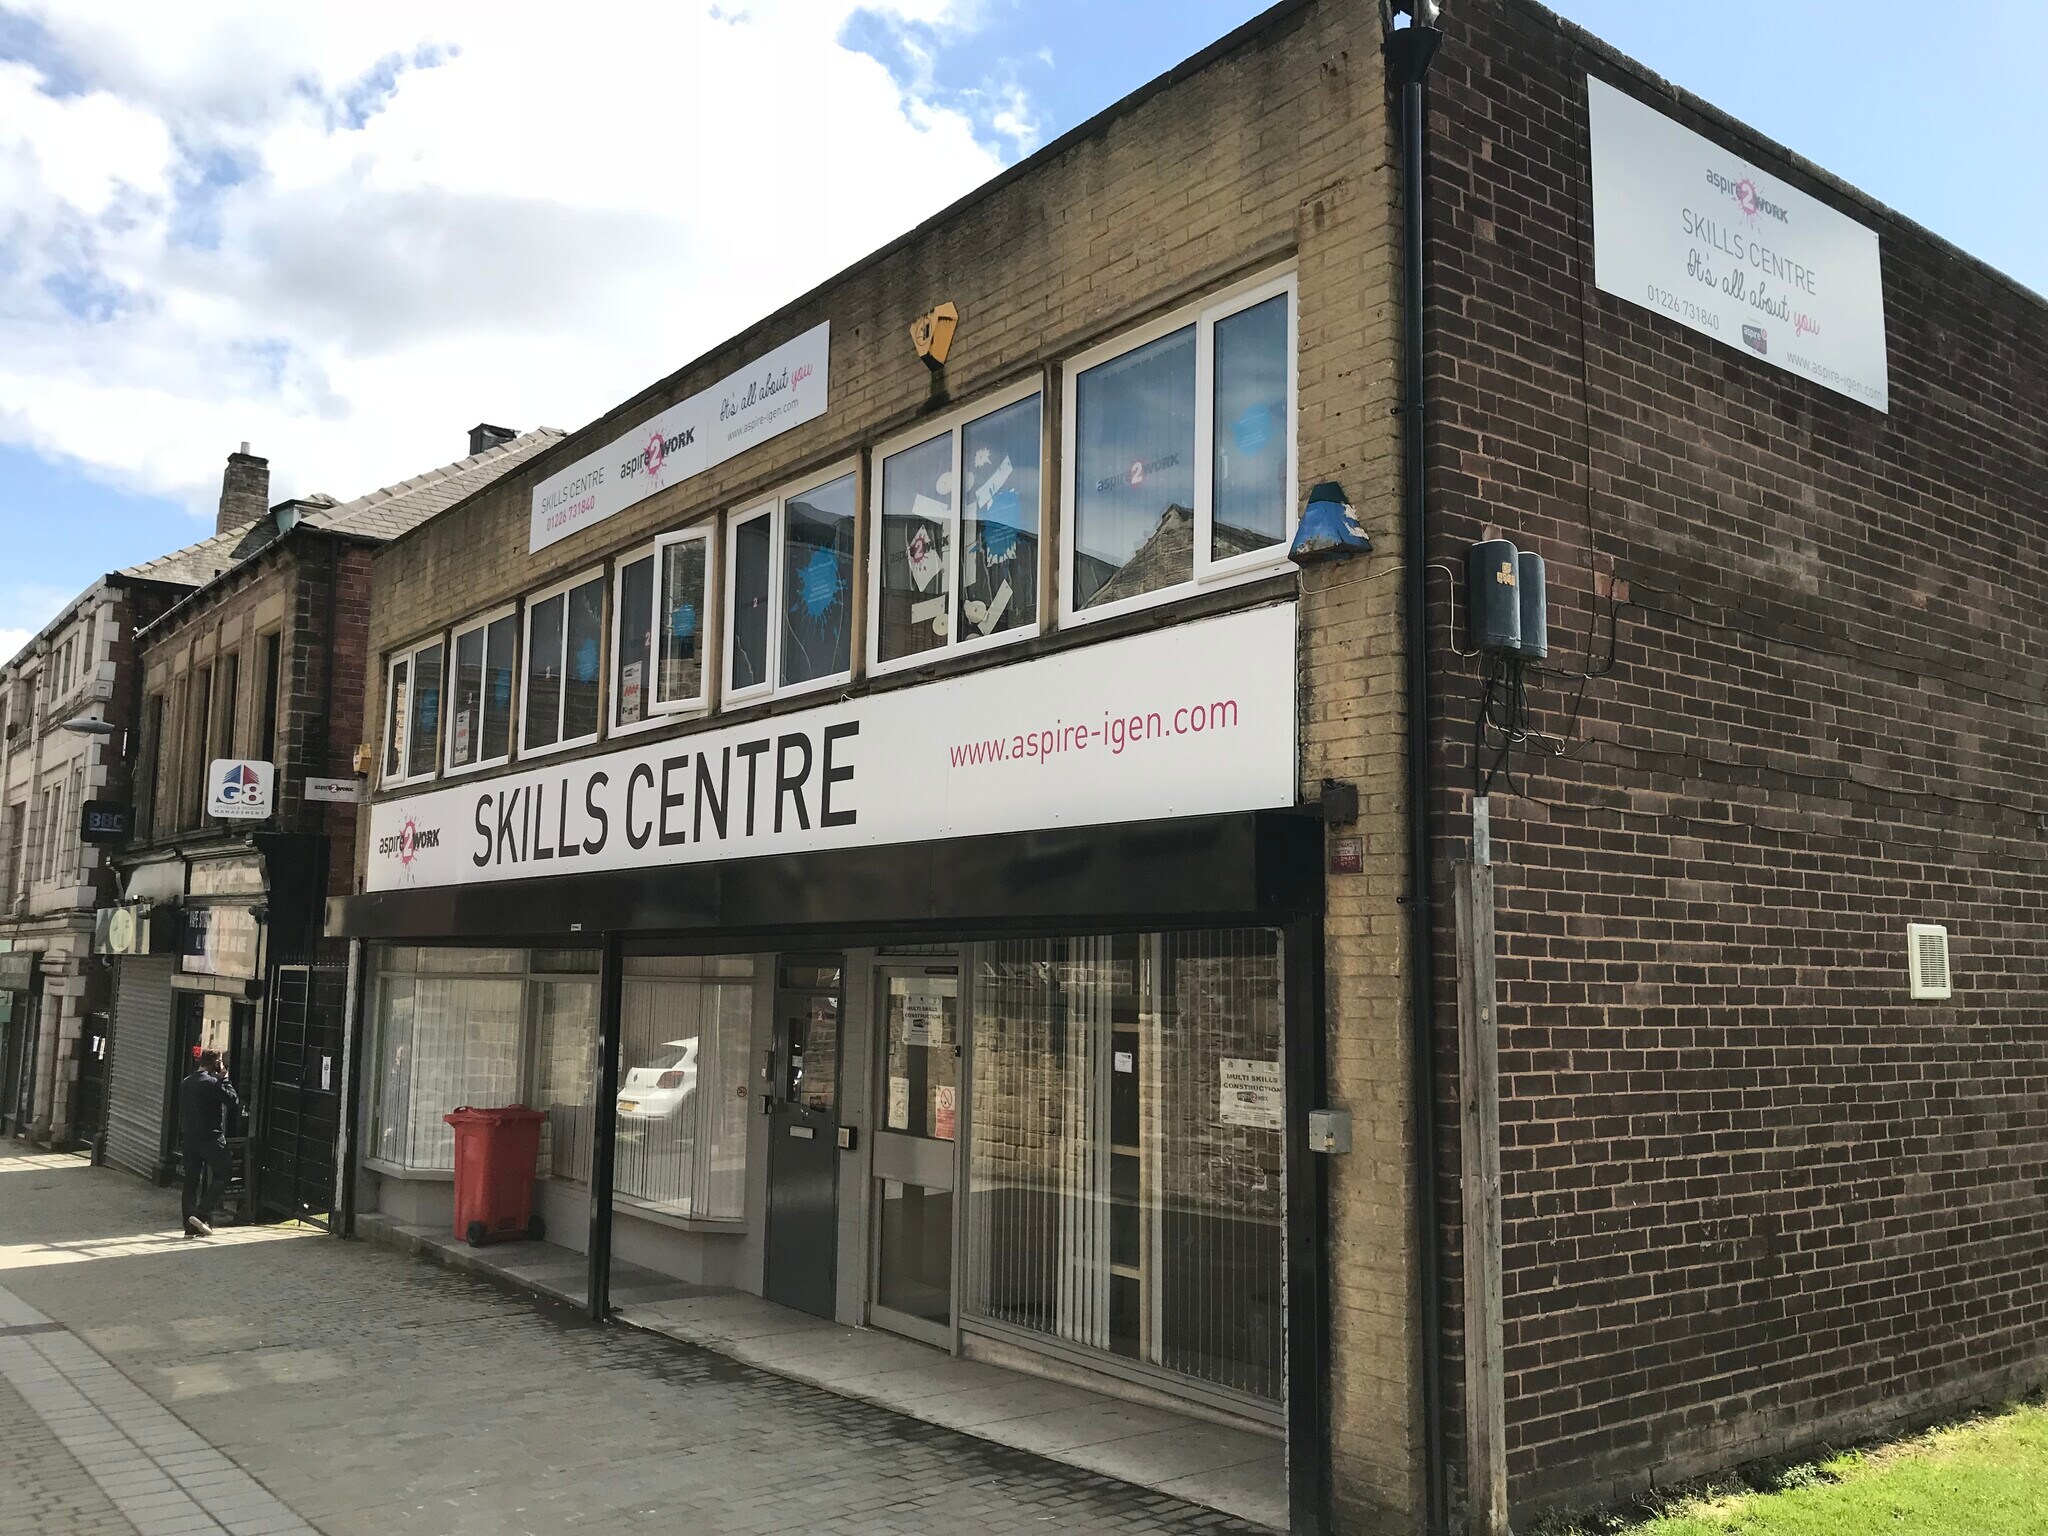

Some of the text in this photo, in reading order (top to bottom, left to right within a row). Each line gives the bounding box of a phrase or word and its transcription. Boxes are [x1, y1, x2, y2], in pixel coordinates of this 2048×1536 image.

[1706, 169, 1789, 224] aspire2WORK
[1682, 208, 1816, 296] SKILLS CENTRE
[1647, 284, 1719, 331] 01226 731840
[1687, 248, 1820, 337] It's all about you
[720, 364, 813, 422] It's all about you
[1787, 350, 1882, 401] www.aspire-igen.com
[727, 399, 799, 441] www.aspire-igen.com
[620, 425, 696, 479] aspire2WORK
[541, 467, 605, 514] SKILLS CENTRE
[547, 495, 596, 531] 01226 731840
[950, 699, 1238, 768] www.aspire-igen.com
[216, 782, 264, 805] G8
[472, 720, 860, 868] SKILLS CENTRE
[379, 826, 441, 859] aspire2WORK
[1223, 1082, 1282, 1092] CONSTRUCTION
